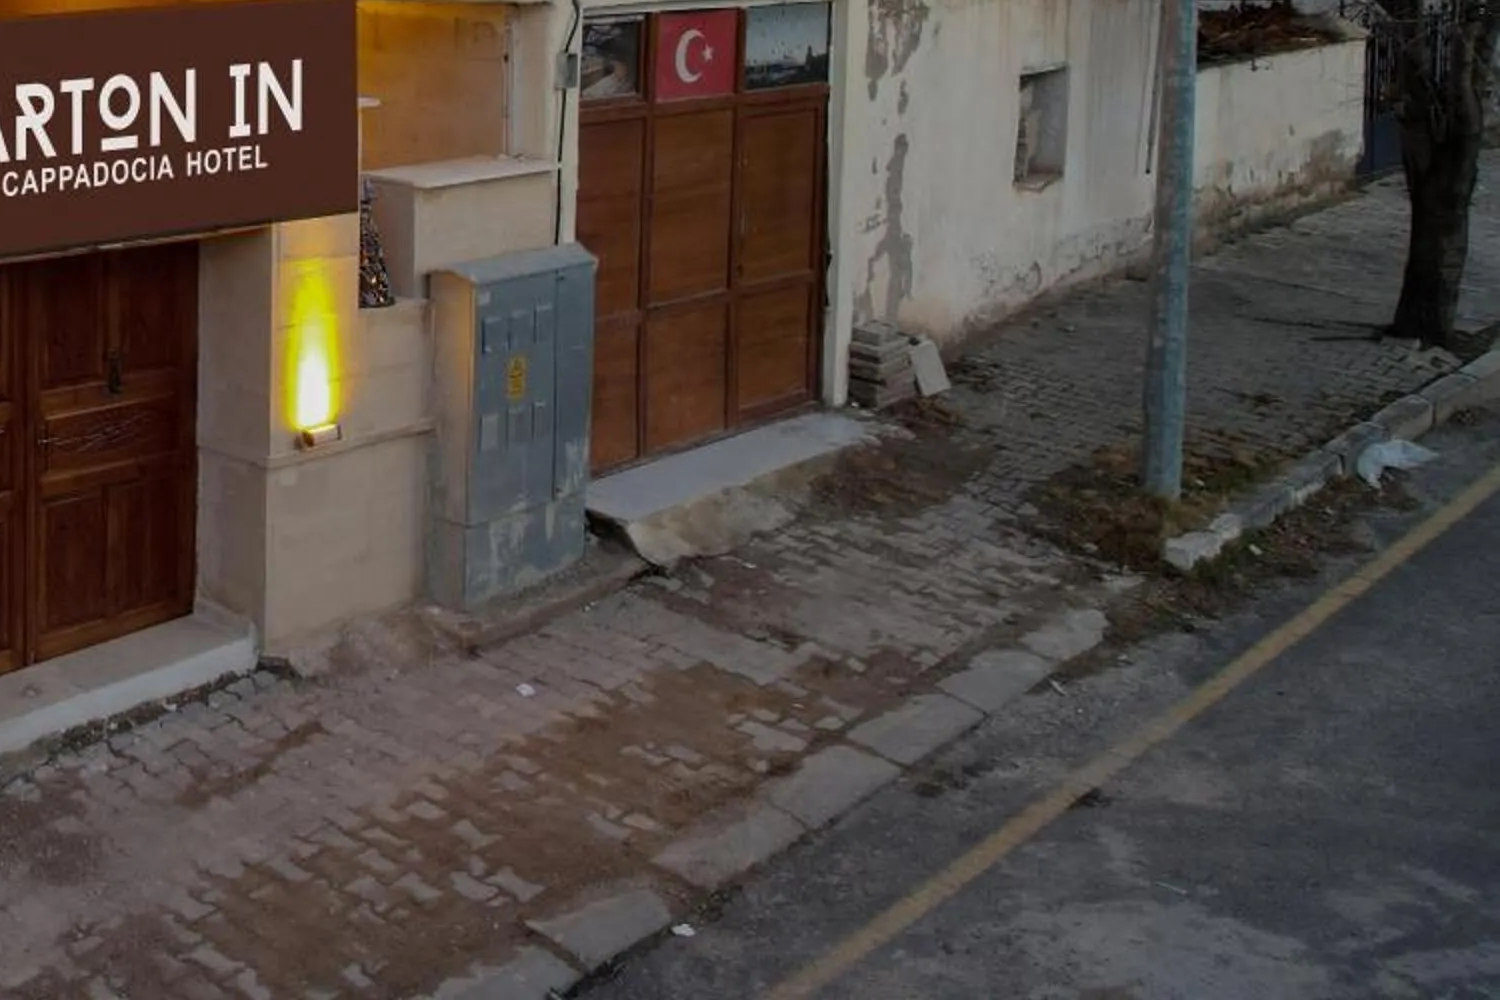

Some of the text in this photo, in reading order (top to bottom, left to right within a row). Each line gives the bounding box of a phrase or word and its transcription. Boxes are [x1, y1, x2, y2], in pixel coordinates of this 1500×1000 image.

[229, 59, 302, 138] IN
[2, 145, 268, 197] CAPPADOCIA HOTEL
